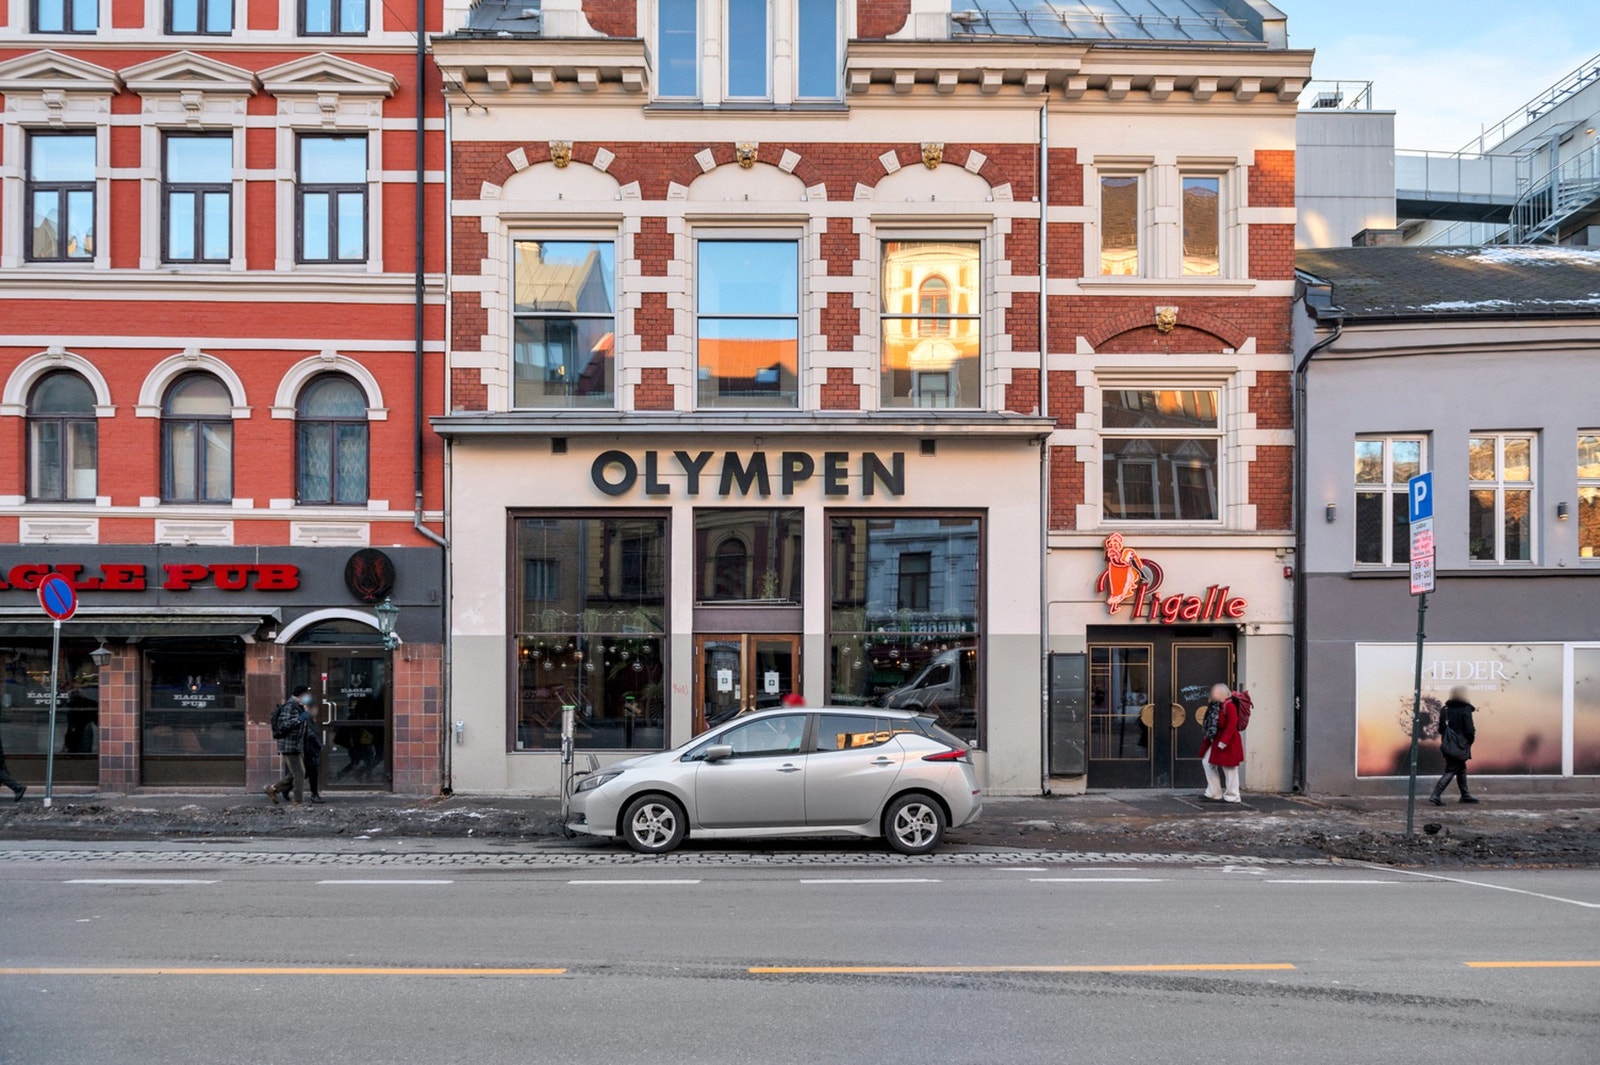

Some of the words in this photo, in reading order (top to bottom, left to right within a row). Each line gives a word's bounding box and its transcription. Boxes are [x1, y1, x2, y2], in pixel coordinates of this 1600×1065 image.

[591, 450, 905, 497] OLYMPEN
[1415, 481, 1427, 515] P
[0, 563, 147, 591] GLE
[163, 563, 300, 591] PUB
[1096, 557, 1248, 625] Pigalle
